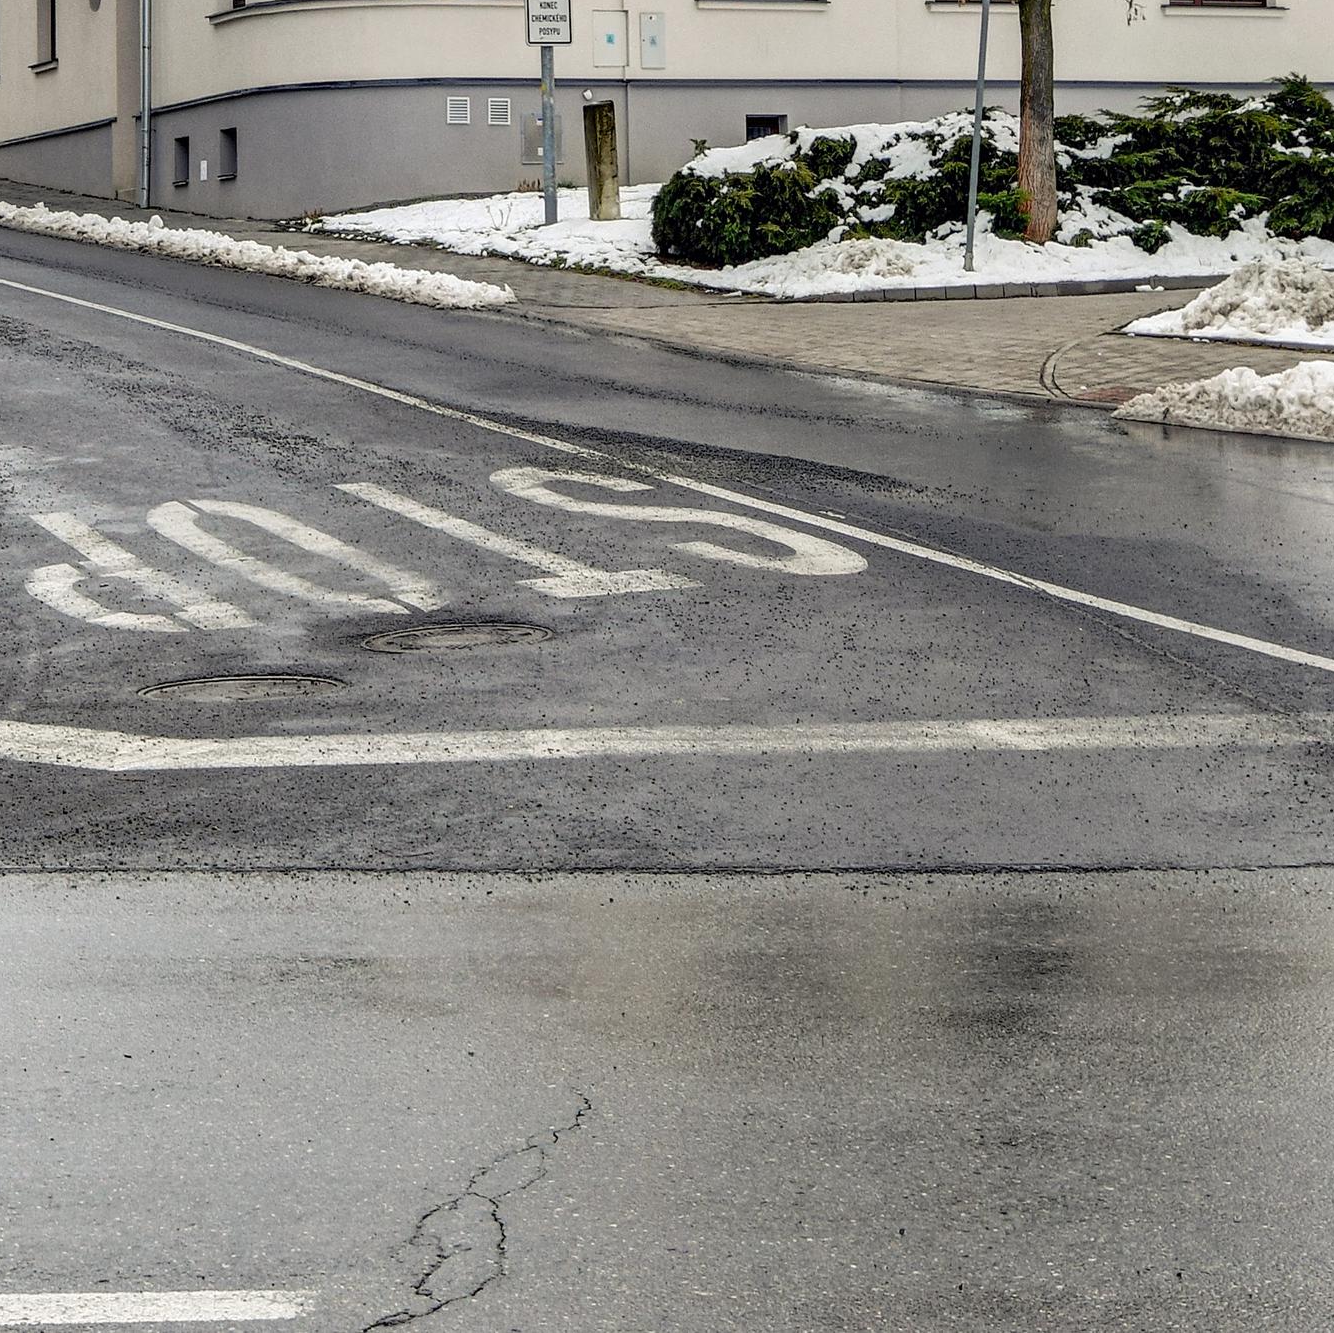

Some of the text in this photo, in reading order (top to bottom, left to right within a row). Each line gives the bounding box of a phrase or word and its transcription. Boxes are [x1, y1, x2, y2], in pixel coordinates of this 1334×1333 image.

[539, 1, 558, 10] KONEC
[531, 13, 568, 23] CHEMICKÉHO
[538, 27, 561, 36] POSYPU
[25, 467, 869, 634] STOP
